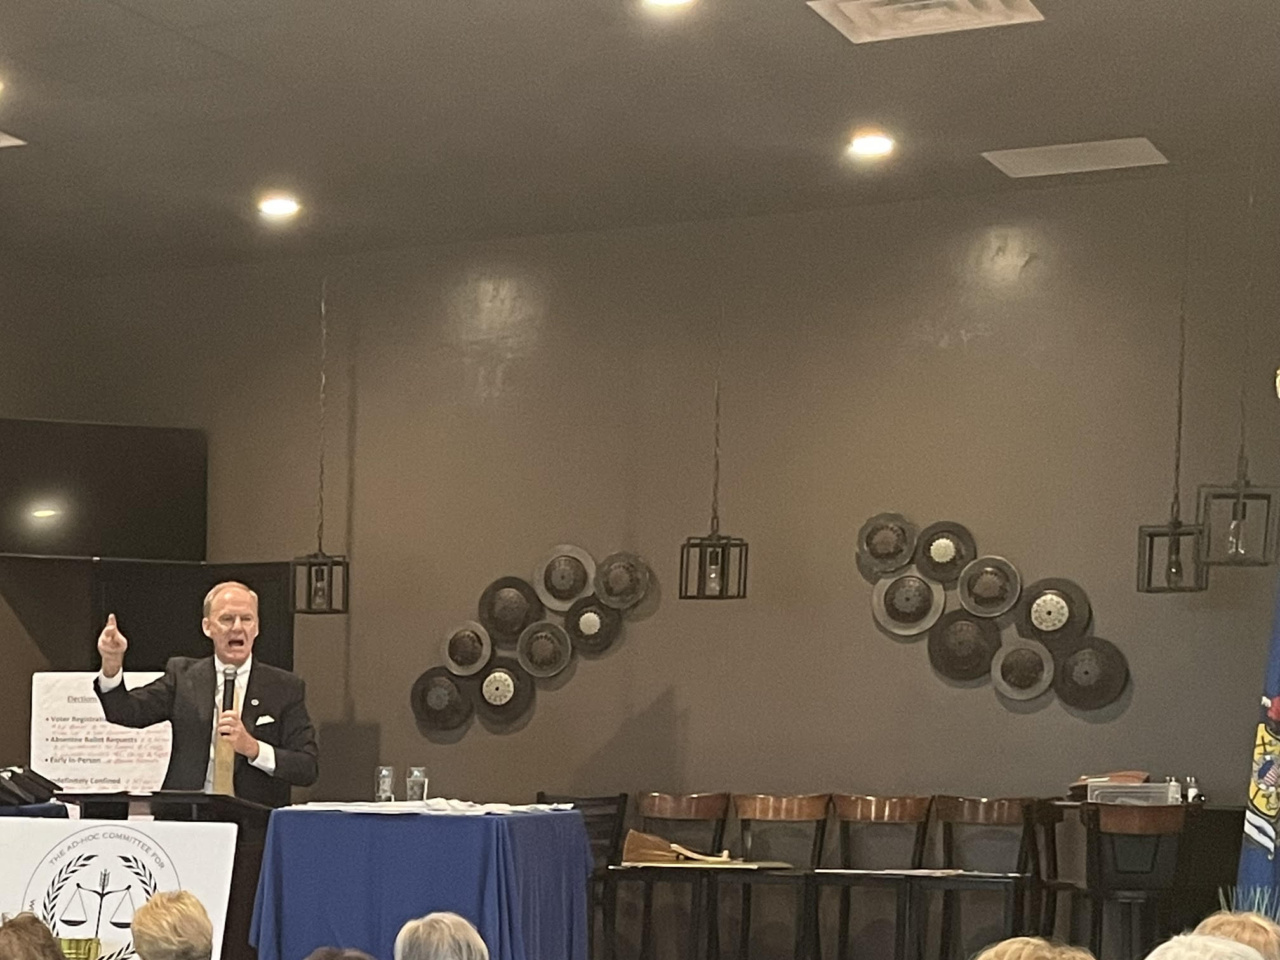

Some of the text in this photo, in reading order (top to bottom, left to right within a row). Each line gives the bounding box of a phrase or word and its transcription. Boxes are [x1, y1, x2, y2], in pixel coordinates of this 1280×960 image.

[49, 832, 165, 869] THE AD-HOC COMMITTEE FOR
